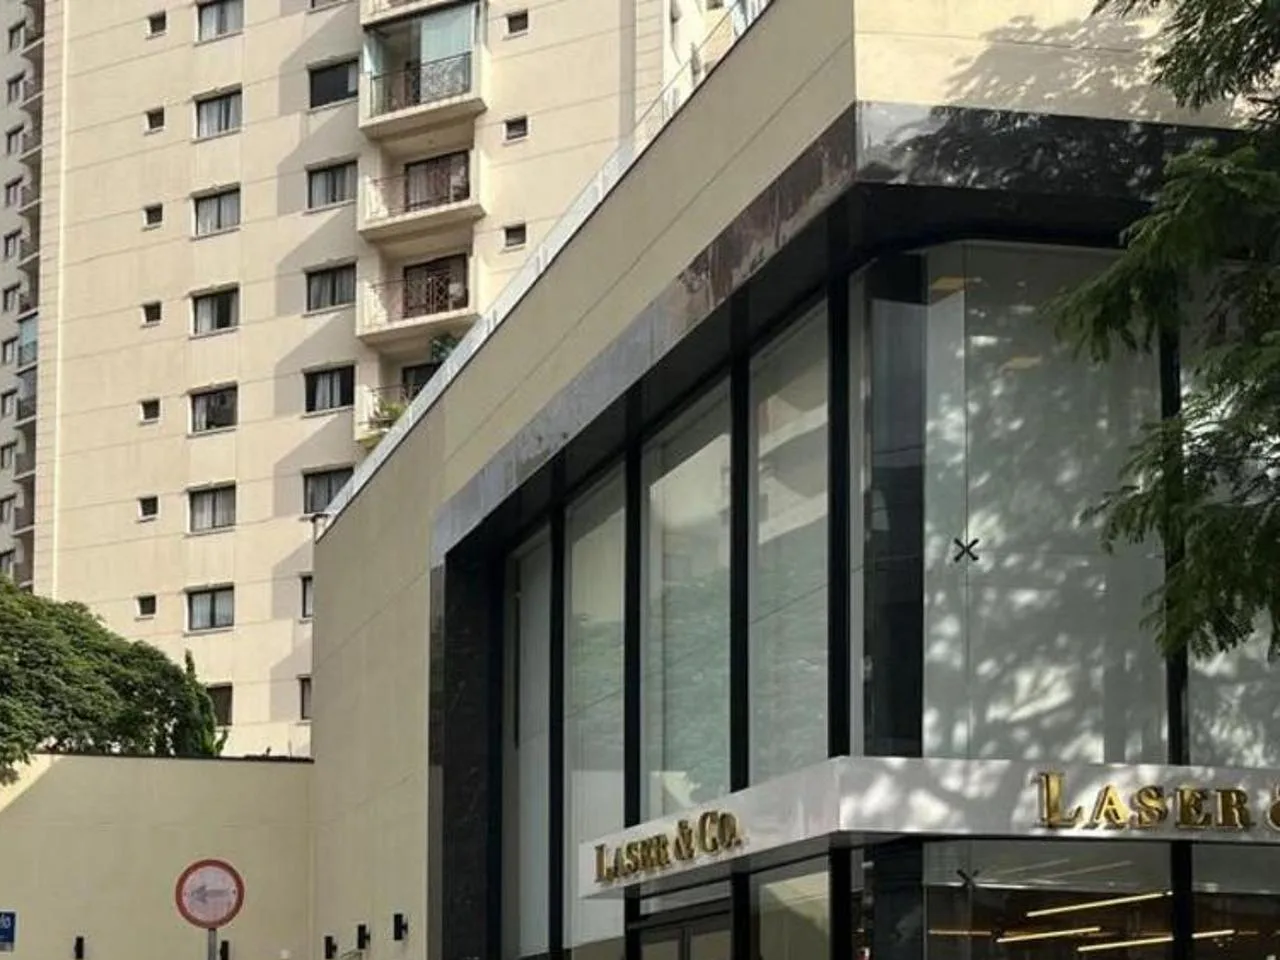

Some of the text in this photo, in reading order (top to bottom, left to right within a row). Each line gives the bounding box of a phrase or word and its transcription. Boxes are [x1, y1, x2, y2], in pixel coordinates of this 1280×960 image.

[1032, 772, 1256, 829] LASER
[595, 834, 671, 882] LASER
[674, 819, 695, 860] &
